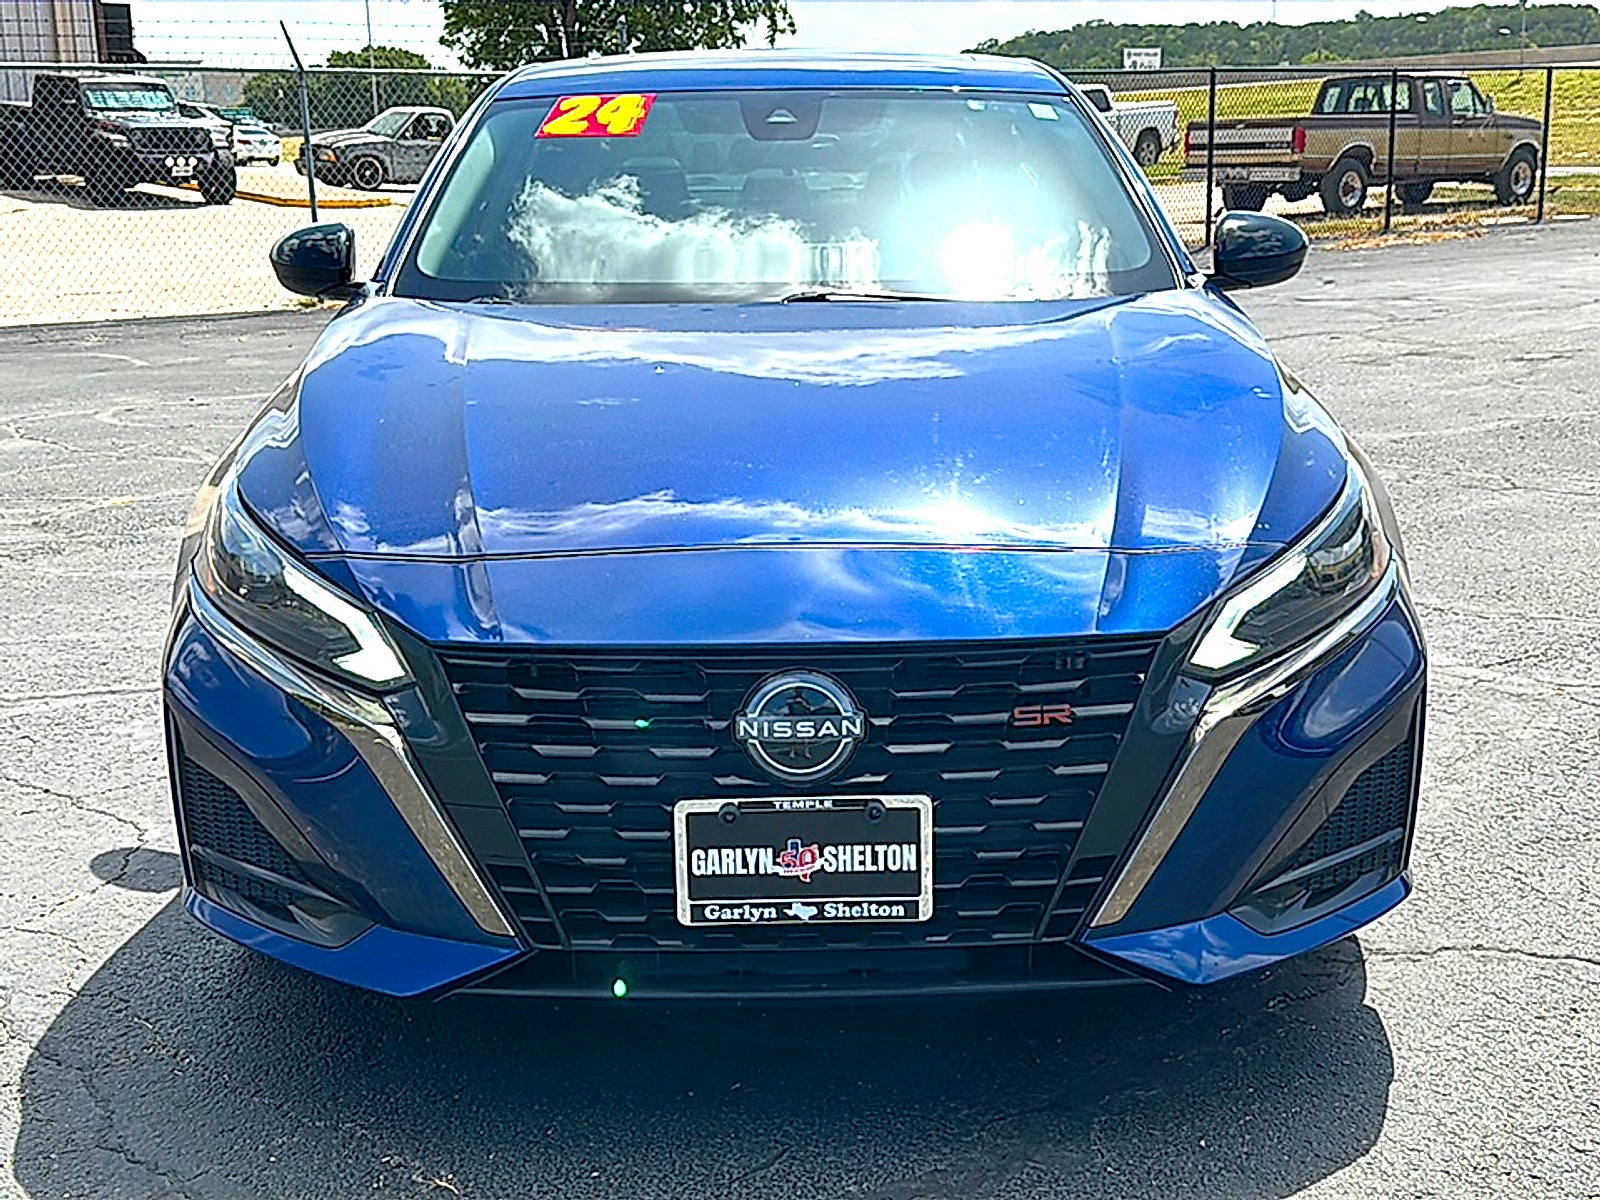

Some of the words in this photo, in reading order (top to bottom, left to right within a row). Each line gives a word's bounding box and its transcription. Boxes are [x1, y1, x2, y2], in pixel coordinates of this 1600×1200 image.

[542, 93, 645, 134] 24
[1013, 704, 1073, 726] SR
[740, 719, 860, 738] NISSAN
[773, 800, 833, 809] TEMPLE
[691, 848, 774, 876] GARLYN
[823, 844, 917, 873] SHELTON
[704, 905, 777, 922] Garlyn
[823, 903, 905, 918] Shelton
